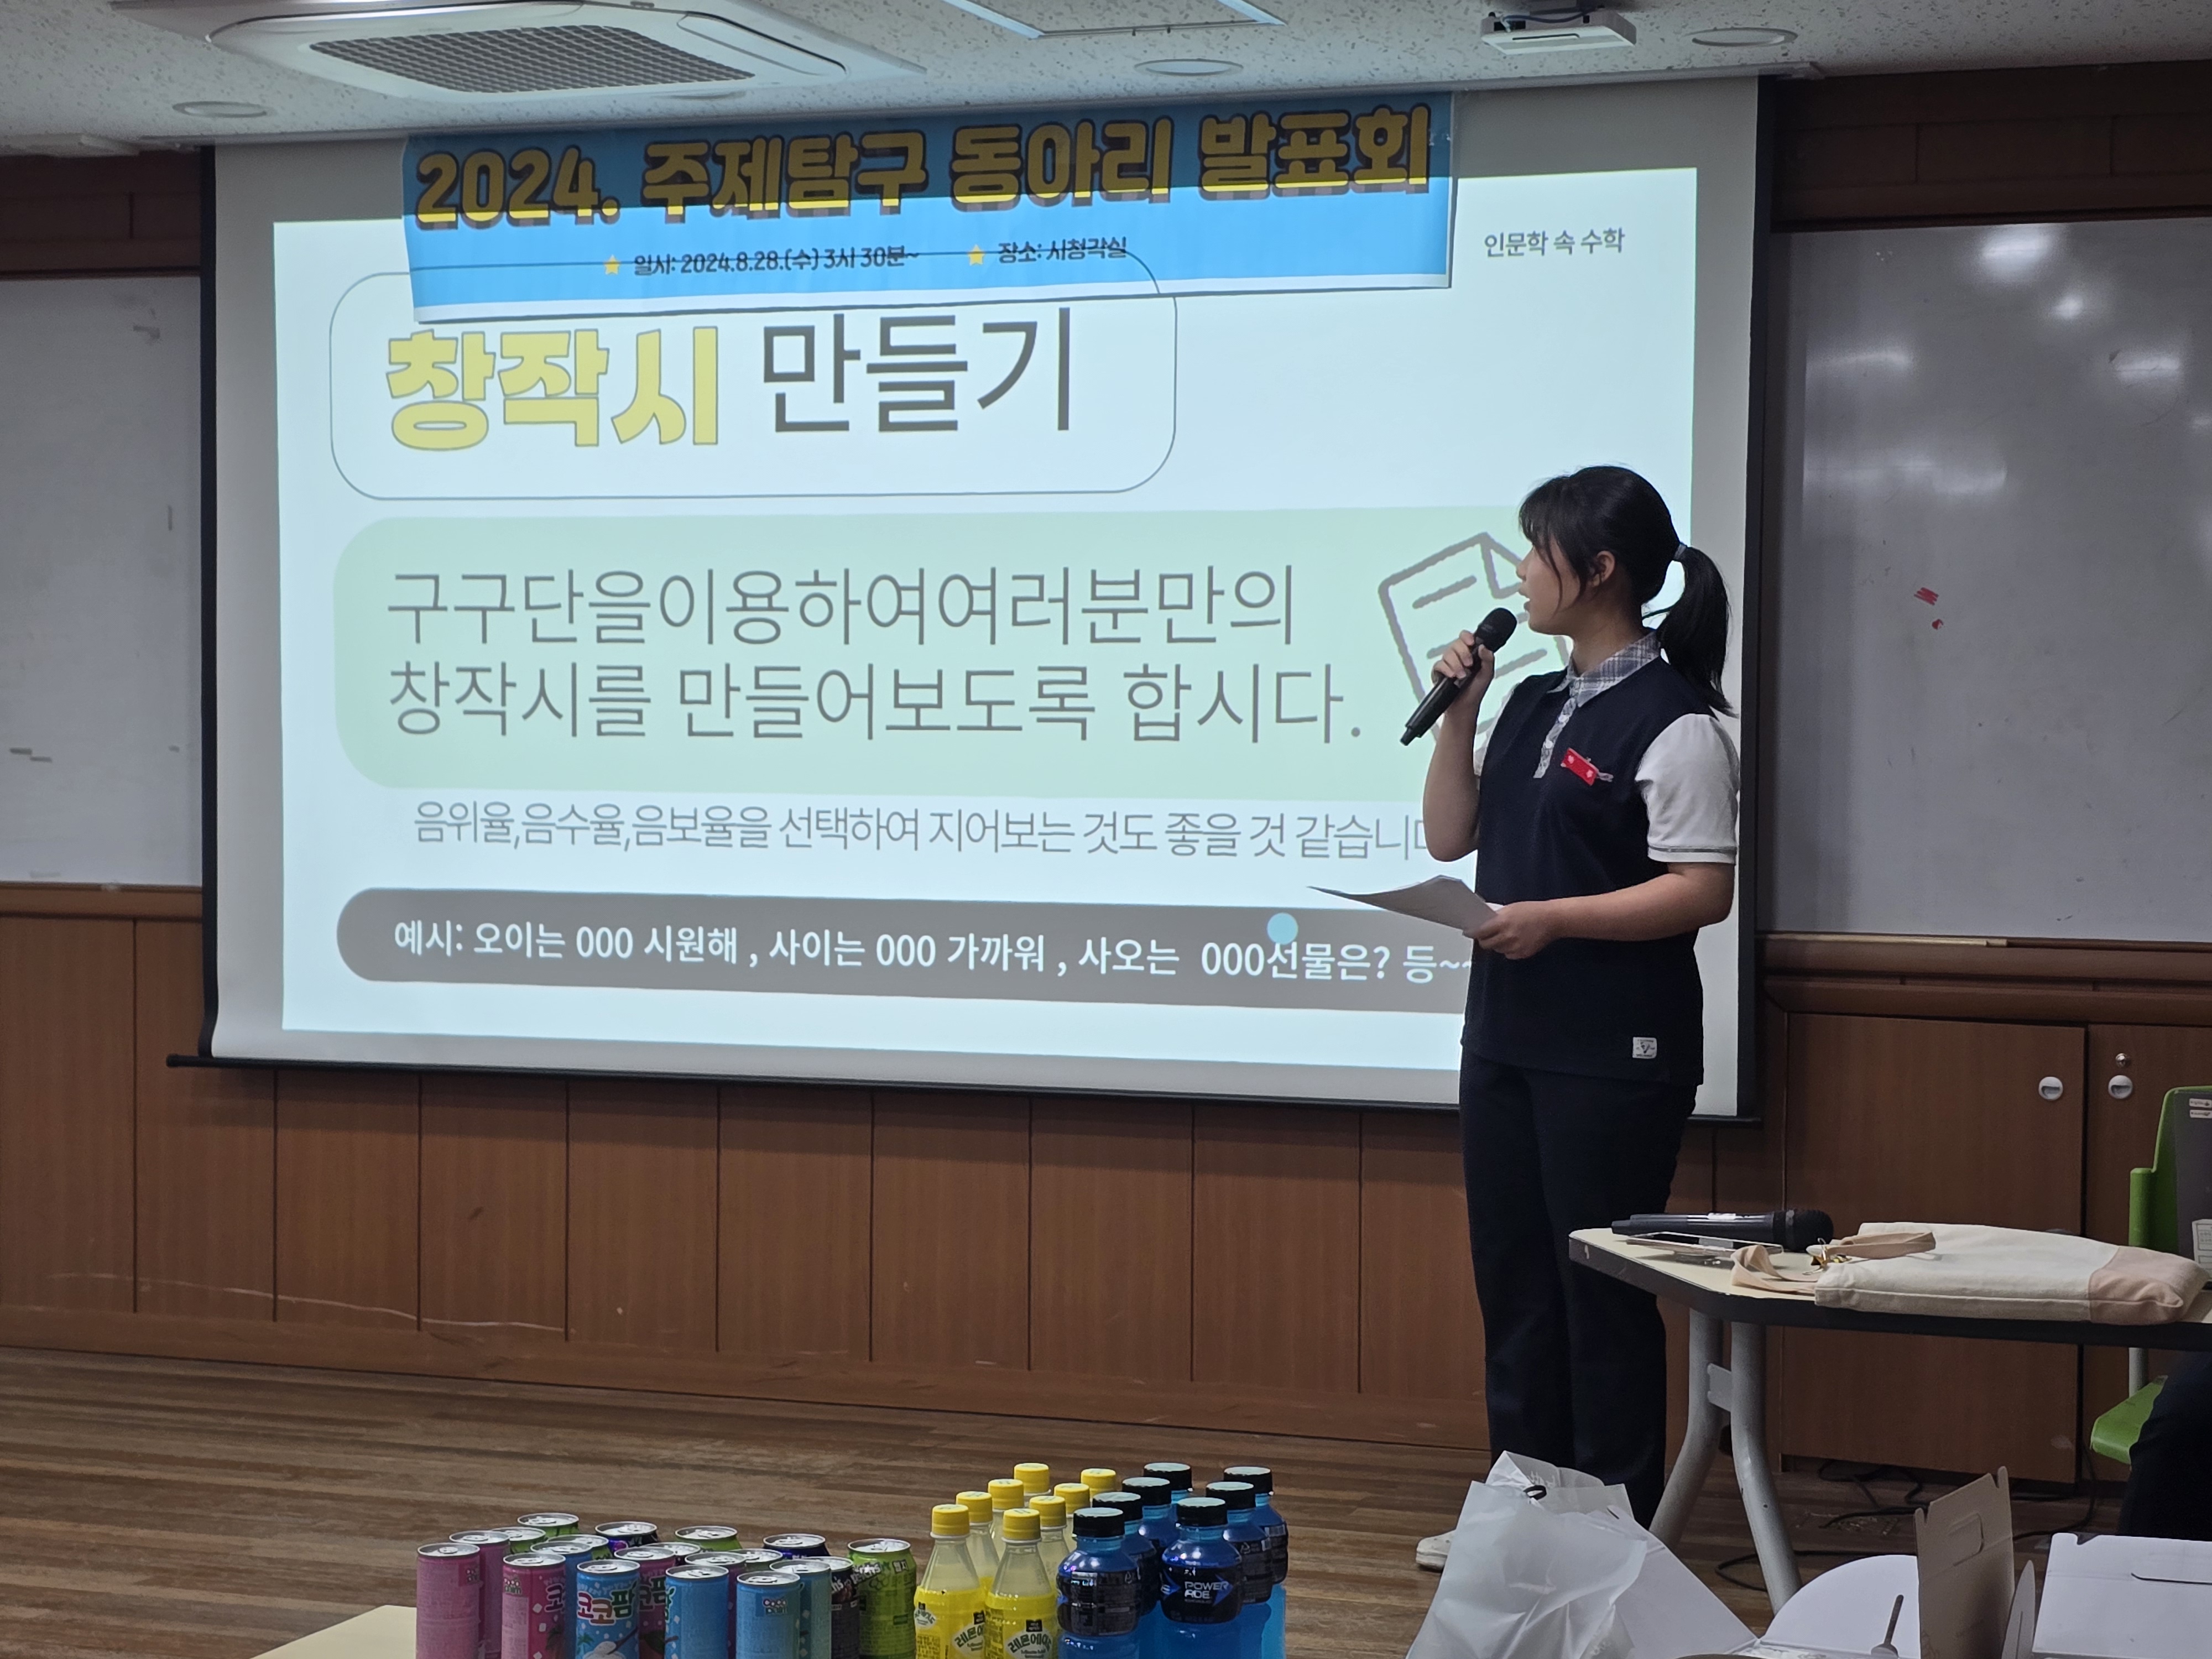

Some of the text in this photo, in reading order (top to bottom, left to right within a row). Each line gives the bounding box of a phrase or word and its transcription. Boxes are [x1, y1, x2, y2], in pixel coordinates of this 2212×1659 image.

[416, 105, 1431, 229] 2024. 주제탐구 동아리 발표회
[634, 254, 675, 276] 일시:
[681, 248, 818, 274] 2024.8.28.(수)
[823, 247, 855, 269] 3시
[998, 236, 1127, 264] 장소: 시청각실
[1484, 227, 1626, 258] 인문학 속 수학
[385, 307, 1071, 451] 창작시 만들기
[388, 565, 1292, 645] 구구단을이용하여여러분만의
[390, 661, 1360, 744] 창작시를 만들어보도록 합시다.
[779, 806, 919, 851] 선택하여
[929, 809, 1075, 853] 지어보는
[1083, 811, 1157, 854] 것도
[1165, 813, 1241, 857] 좋을
[1250, 813, 1286, 857] 것
[395, 920, 463, 957] 예시:
[474, 921, 565, 958] 오이는
[644, 925, 737, 964] 시원해
[769, 929, 865, 967] 사이는
[947, 933, 1044, 972] 가까워
[1078, 937, 1180, 975] 사오는
[578, 1580, 638, 1624] 코코팜
[1184, 1581, 1229, 1591] POWER
